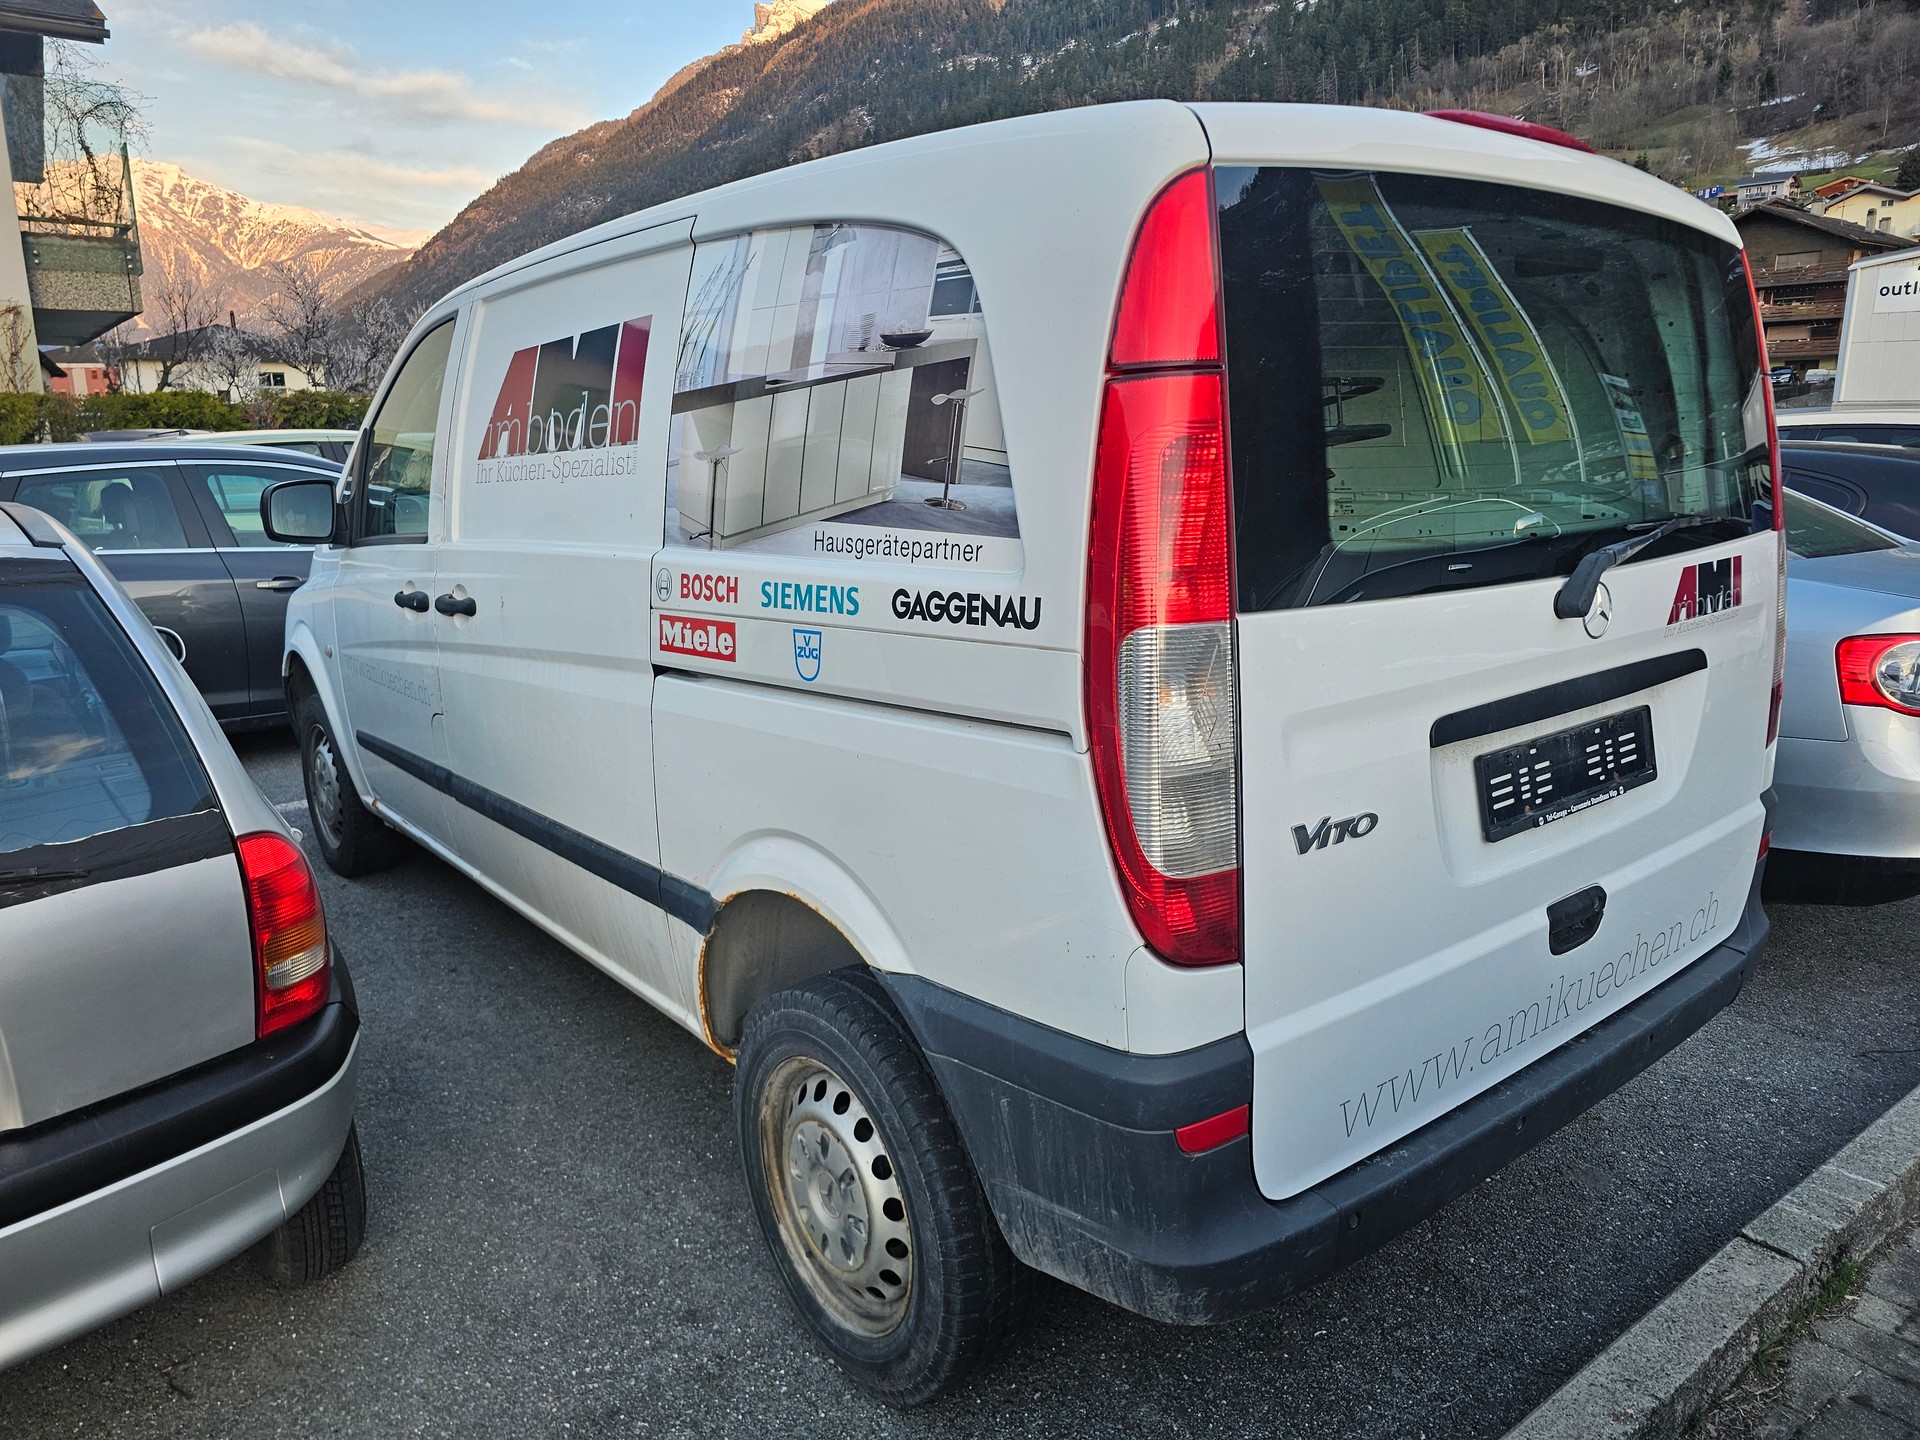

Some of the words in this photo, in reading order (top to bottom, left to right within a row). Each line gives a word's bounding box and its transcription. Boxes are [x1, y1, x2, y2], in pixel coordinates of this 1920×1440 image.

[1879, 280, 1920, 297] outl
[486, 391, 638, 459] imboden
[476, 463, 493, 484] Ihr
[496, 451, 633, 484] Küchen-Spezialist
[813, 530, 983, 563] Hausgerätepartner
[680, 573, 739, 604] BOSCH
[761, 581, 859, 616] SIEMENS
[892, 588, 1042, 630] GAGGENAU
[660, 619, 734, 656] Miele
[797, 646, 818, 660] ZUG
[1340, 891, 1719, 1138] www.amikuechen.ch
